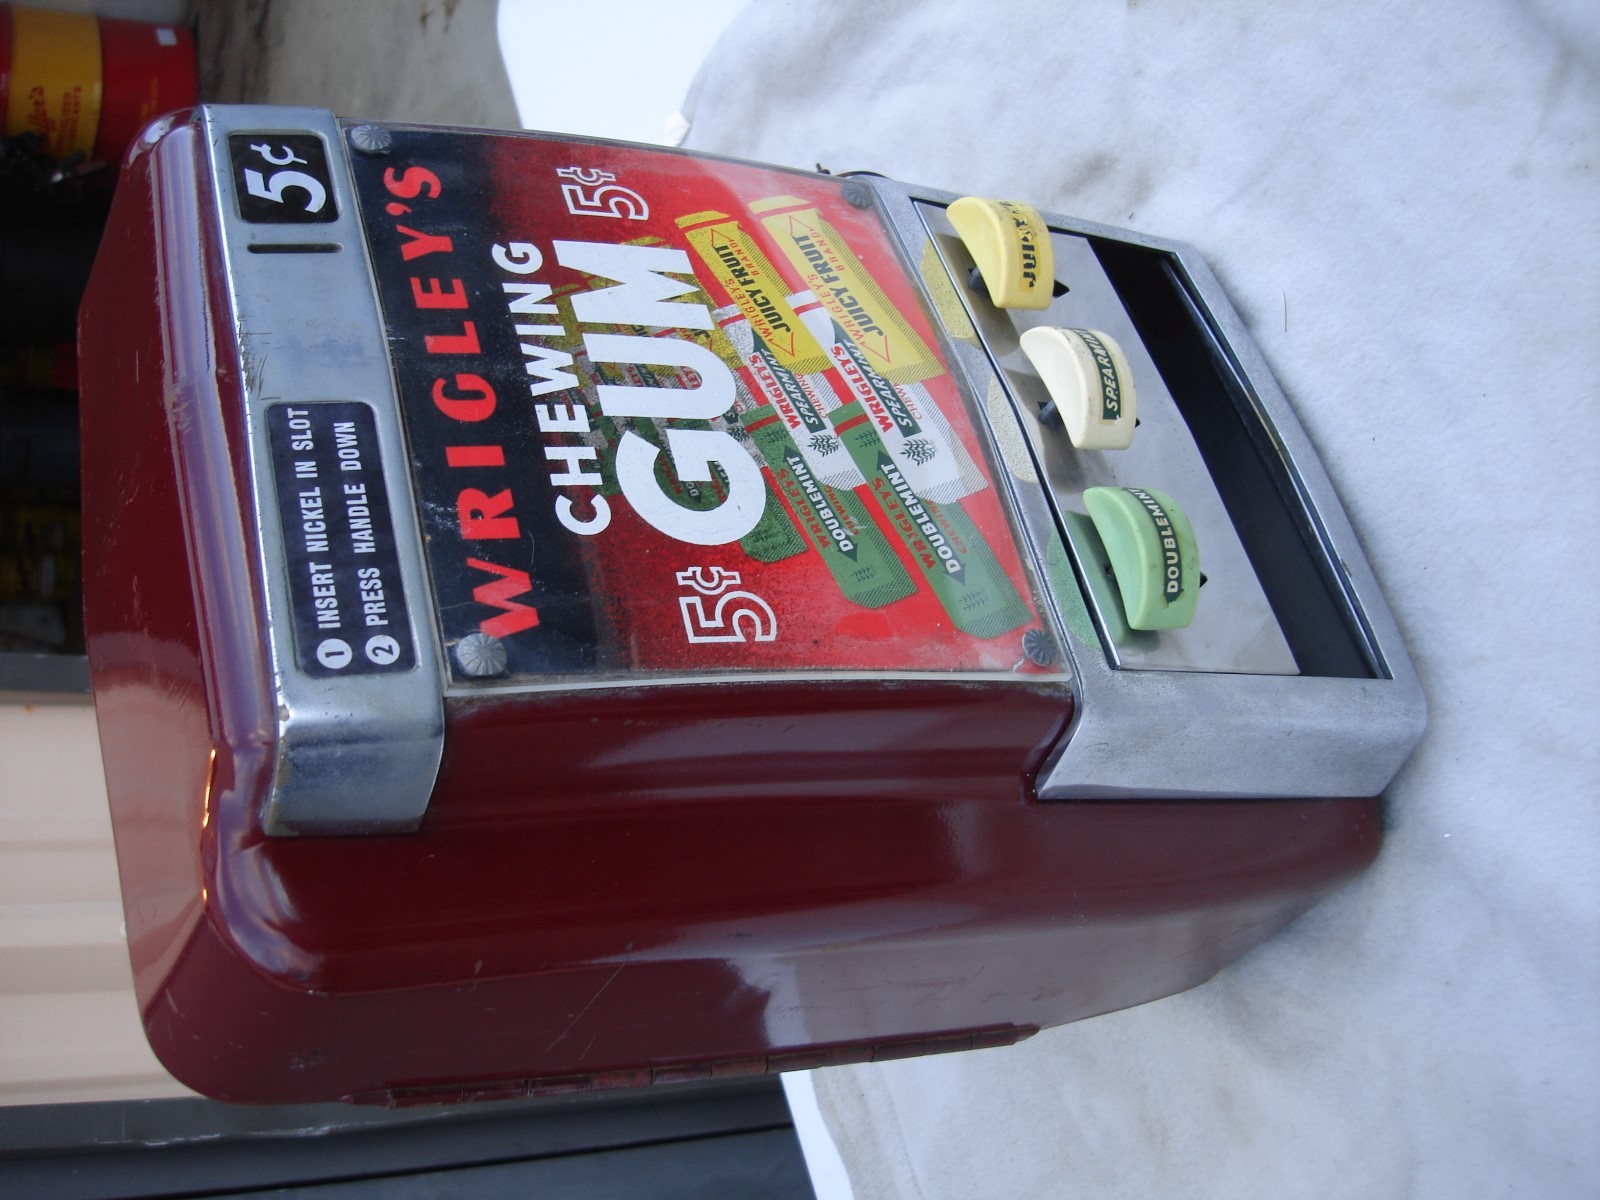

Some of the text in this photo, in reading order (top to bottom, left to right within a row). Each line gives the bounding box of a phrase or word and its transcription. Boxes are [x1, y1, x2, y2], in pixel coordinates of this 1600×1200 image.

[244, 144, 327, 213] 5¢
[556, 166, 649, 221] 5¢
[714, 244, 791, 333] JUICY FRUIT
[729, 241, 760, 277] BRAND
[792, 235, 884, 337] JUICY FRUIT
[811, 231, 846, 272] BRAND
[724, 278, 773, 342] WRIGLEY'S
[807, 273, 865, 342] WRIGLEY'S
[383, 166, 539, 639] WRIGLEY'S
[491, 242, 611, 535] CHEWING
[552, 240, 767, 546] GUM
[749, 354, 801, 430] WRIGLEY'S
[760, 348, 819, 425] SPEARMINT
[830, 345, 894, 433] WRIGLEY'S
[843, 338, 913, 428] SPEARMINT
[1073, 329, 1119, 412] SPEARMINT
[287, 407, 314, 451] SLOT
[333, 421, 362, 471] DOWN
[294, 461, 319, 478] IN
[786, 456, 854, 552] DOUBLEMINT
[299, 486, 329, 552] NICKEL
[343, 483, 376, 553] HANDLE
[871, 477, 937, 570] WRIGLEY'S
[880, 463, 962, 574] DOUBLEMINT
[1127, 488, 1179, 593] DOUBLEMINT
[309, 562, 341, 629] INSERT
[357, 567, 388, 626] PRESS
[676, 566, 777, 643] 5¢
